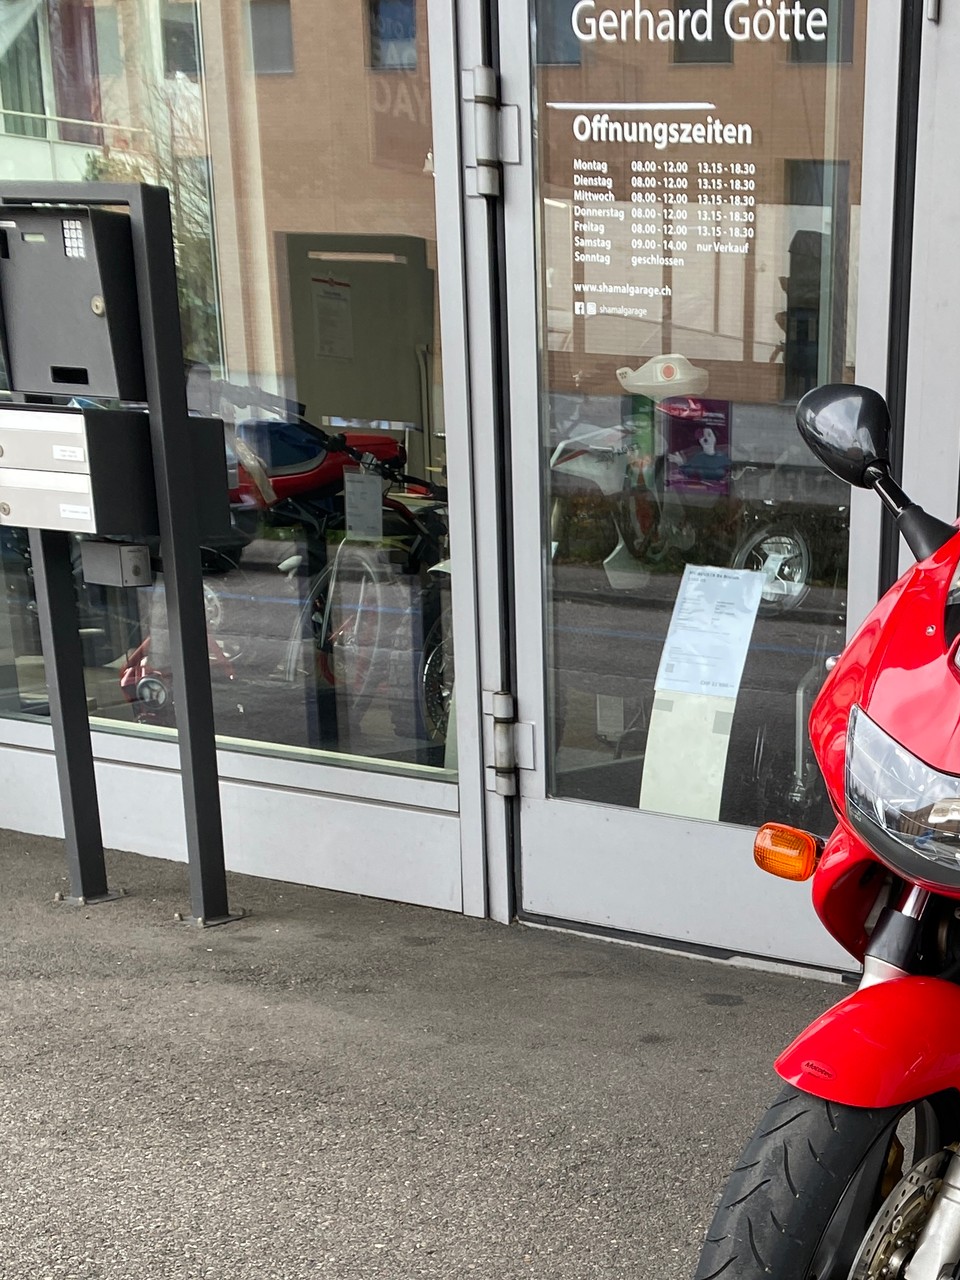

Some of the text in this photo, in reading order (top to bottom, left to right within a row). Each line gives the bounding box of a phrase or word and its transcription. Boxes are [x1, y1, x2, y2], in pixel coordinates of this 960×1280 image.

[571, 0, 828, 41] Gerhard Götte
[573, 159, 608, 174] Montag
[631, 161, 656, 172] 08.00
[663, 161, 688, 173] 12.00
[697, 162, 722, 174] 13.15
[730, 163, 755, 175] 18.30
[573, 175, 613, 189] Dienstag
[631, 176, 656, 188] 08.00
[663, 177, 688, 189] 12.00
[697, 178, 722, 189] 13.15
[730, 179, 755, 190] 18.30
[574, 190, 615, 202] Mittwoch
[631, 192, 656, 203] 08.00
[663, 193, 688, 204] 12.00
[697, 194, 722, 205] 13.15
[730, 195, 755, 206] 18.30
[574, 205, 625, 221] Donnerstag
[631, 208, 656, 218] 08.00
[663, 208, 688, 220] 12.00
[697, 210, 722, 221] 13.15
[730, 210, 755, 222] 18.30
[574, 221, 605, 234] Freitag
[631, 223, 656, 234] 08.00
[663, 224, 688, 235] 12.00
[697, 225, 722, 237] 13.15
[730, 226, 755, 238] 18.30
[574, 236, 611, 250] Samstag
[631, 239, 656, 249] 09.00
[663, 240, 688, 251] 14.00
[696, 243, 712, 252] nur
[713, 241, 750, 254] Verkauf
[574, 251, 684, 266] Sonntag geschlossen
[574, 282, 672, 298] www.shamalgarage.ch
[599, 305, 648, 317] shamalgarage
